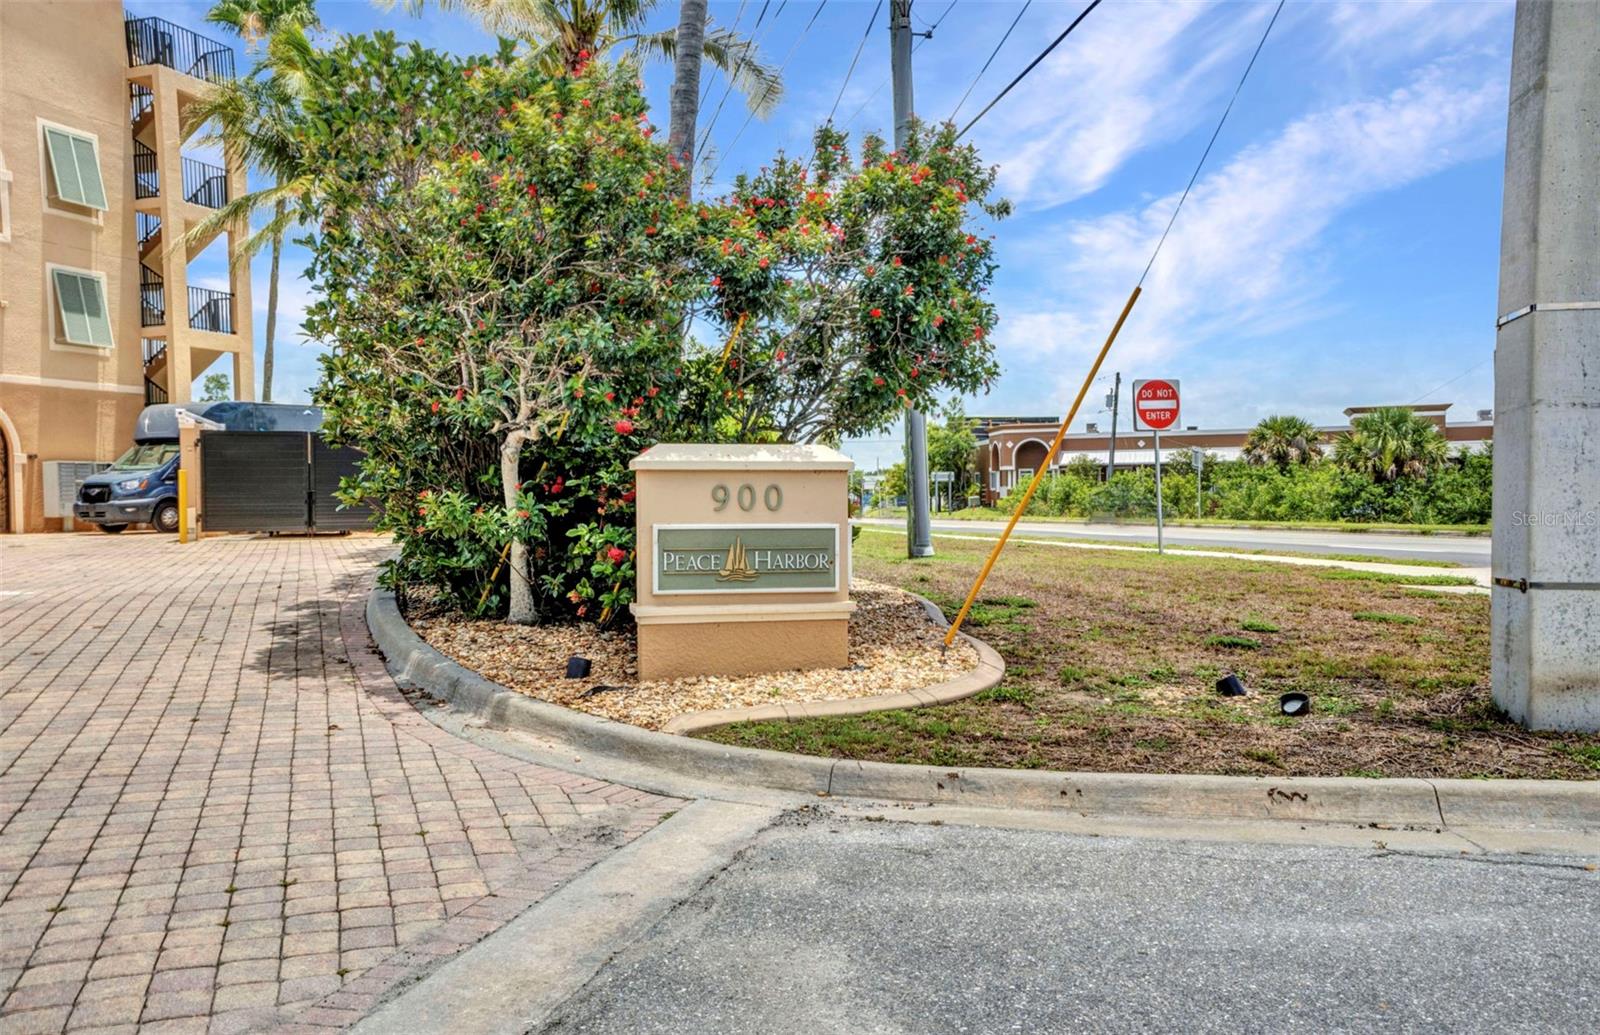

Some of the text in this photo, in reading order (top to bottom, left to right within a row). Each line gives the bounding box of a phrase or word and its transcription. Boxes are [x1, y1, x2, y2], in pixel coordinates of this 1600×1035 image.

[1141, 389, 1173, 398] DO NOT
[1145, 411, 1171, 420] ENTER
[711, 484, 783, 512] 900
[663, 550, 830, 571] PEACE HARBOR
